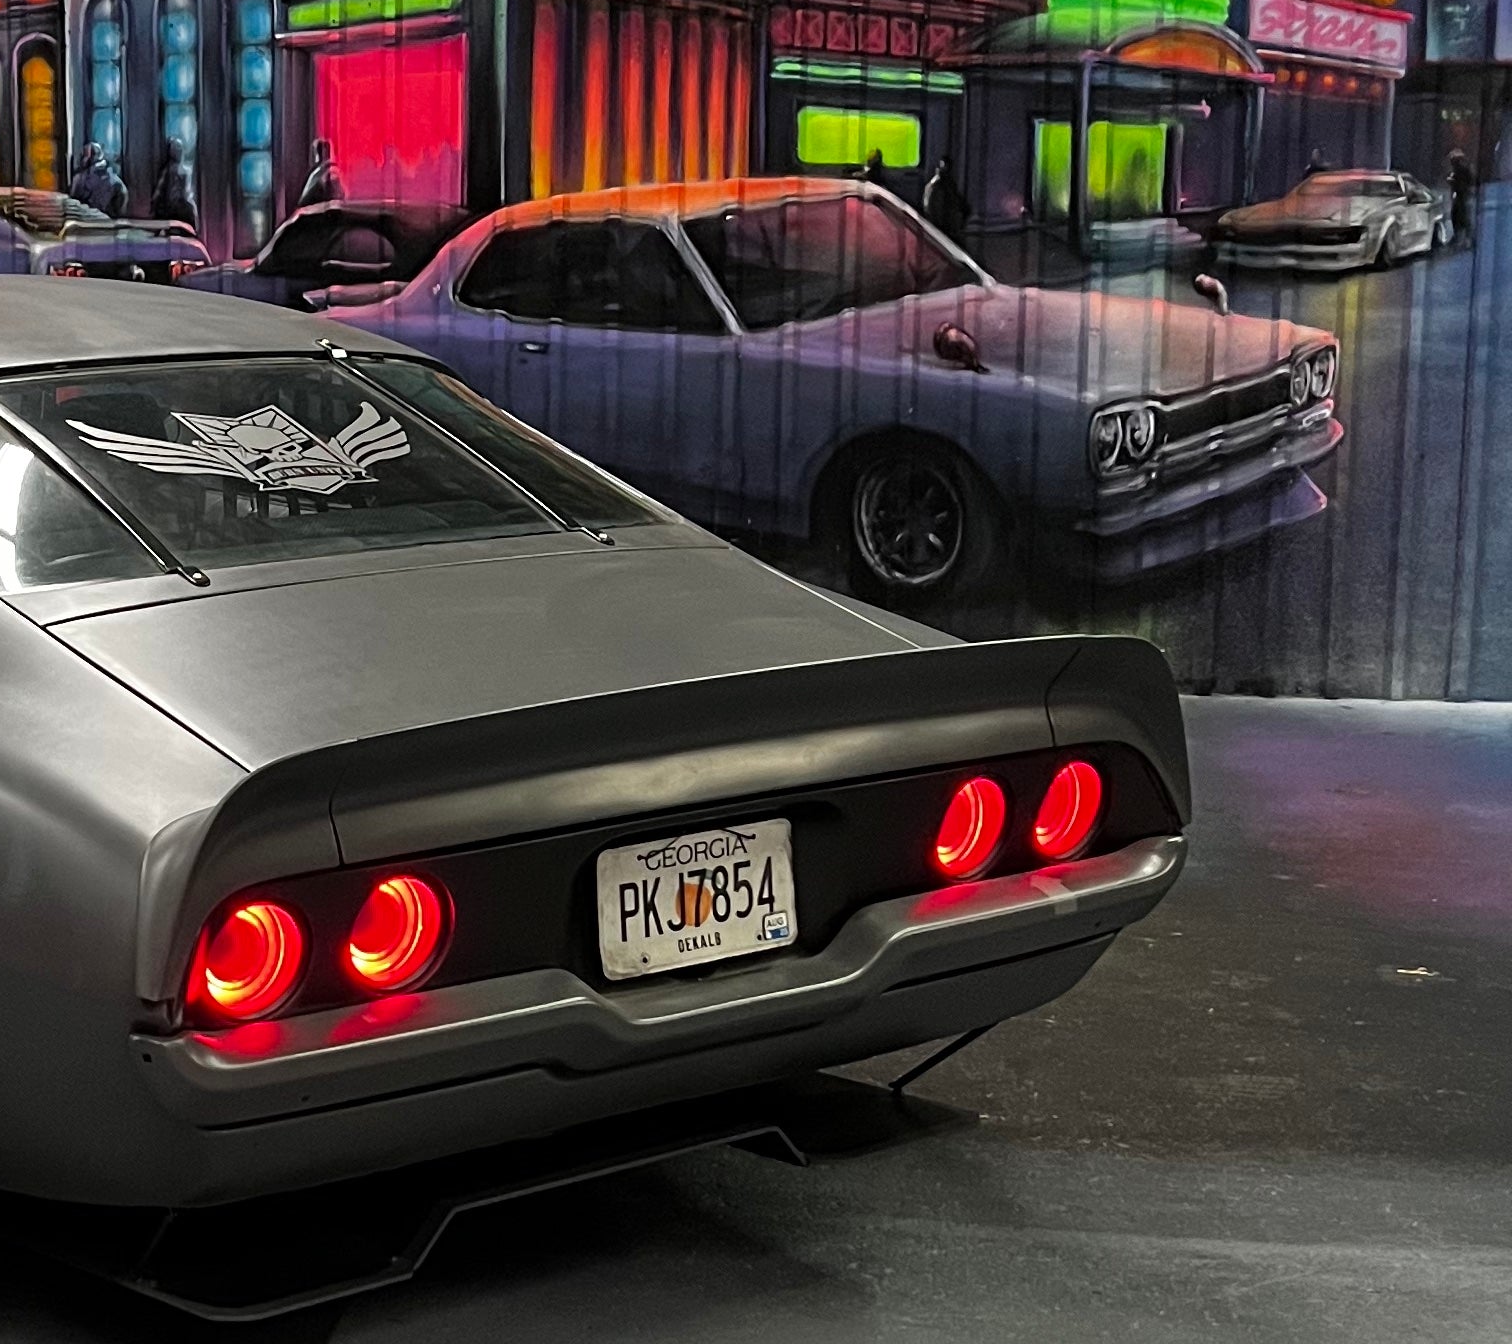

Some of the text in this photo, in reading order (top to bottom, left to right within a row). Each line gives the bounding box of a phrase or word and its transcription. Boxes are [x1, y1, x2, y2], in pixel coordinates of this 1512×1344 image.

[645, 834, 748, 870] GEORGIA
[619, 856, 775, 942] PKJ7854
[678, 931, 722, 953] DEKALB
